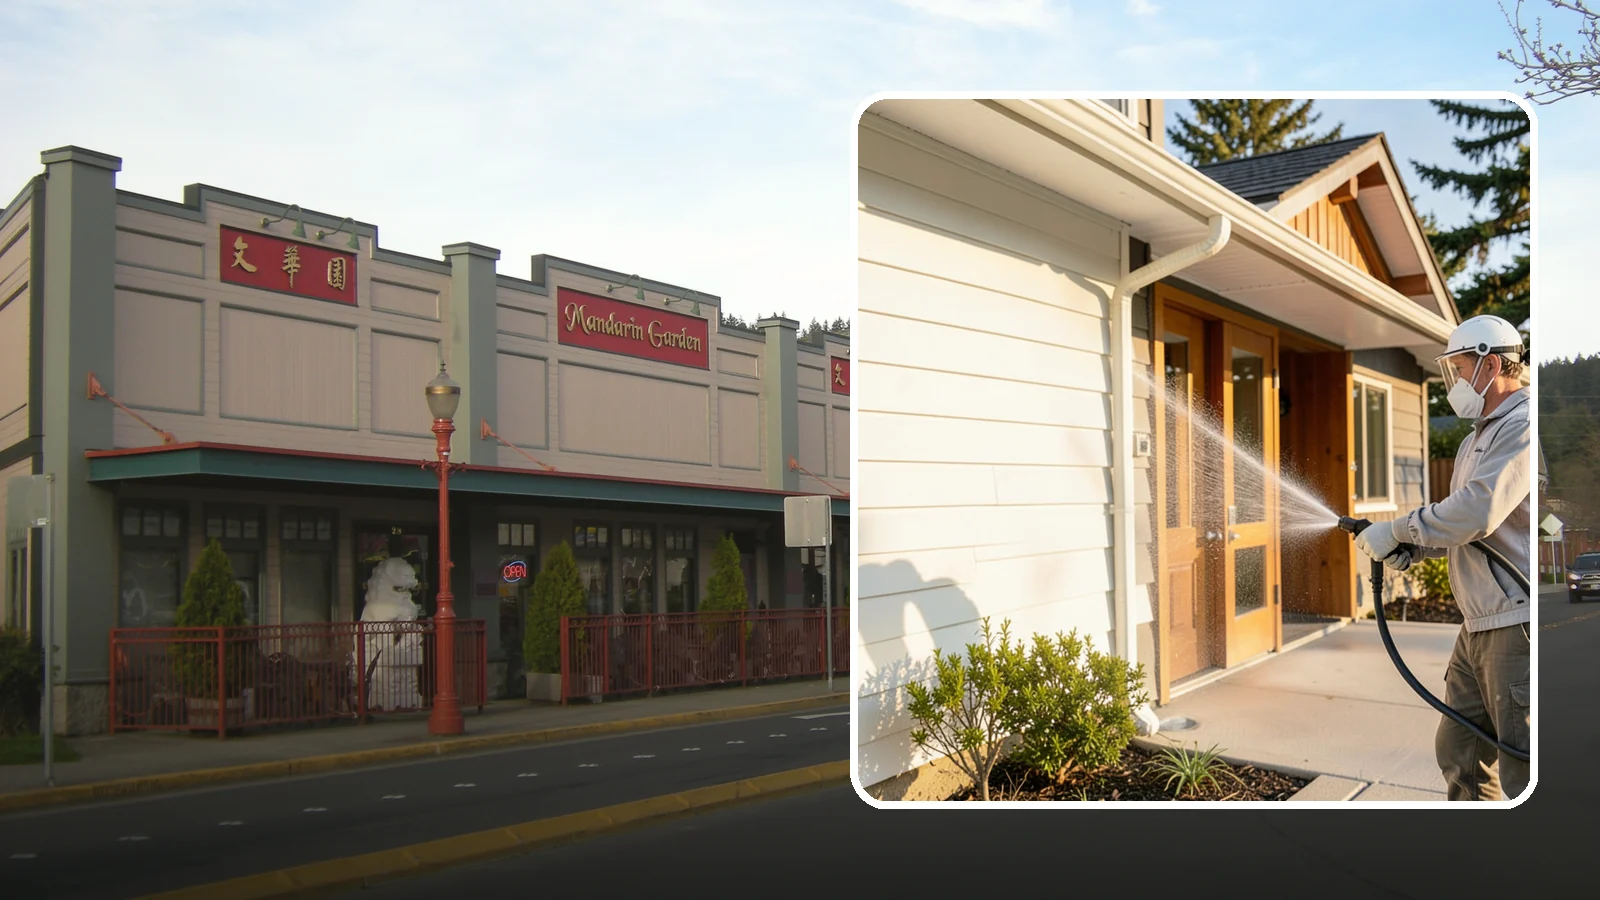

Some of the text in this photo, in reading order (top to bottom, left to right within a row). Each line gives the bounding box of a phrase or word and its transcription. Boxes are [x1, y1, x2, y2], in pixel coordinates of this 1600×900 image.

[230, 235, 347, 291] 文華園
[564, 302, 702, 352] Mandarin Garden
[503, 565, 527, 578] OPEN
